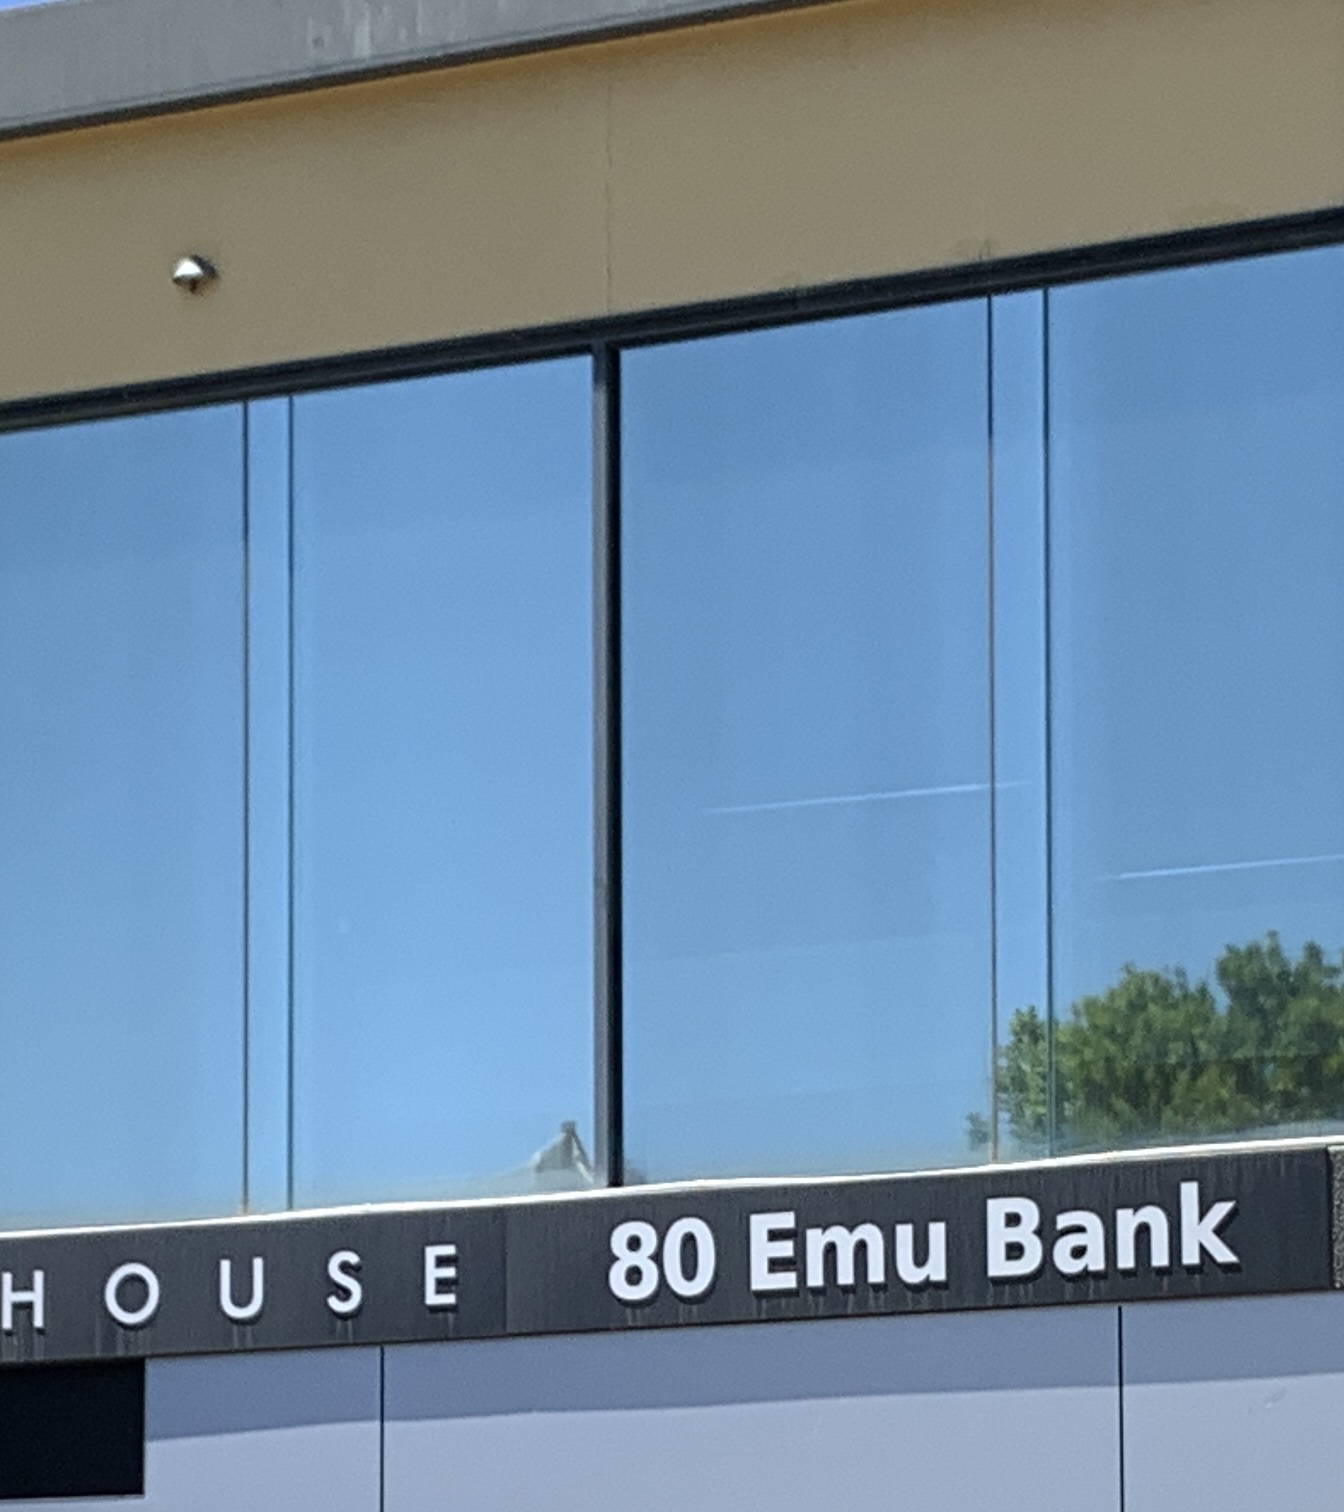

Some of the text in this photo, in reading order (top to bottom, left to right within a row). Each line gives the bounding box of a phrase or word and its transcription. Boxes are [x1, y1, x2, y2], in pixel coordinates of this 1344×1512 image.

[1, 1244, 458, 1334] HOUSE
[609, 1181, 1238, 1300] 80 Emu Bank
